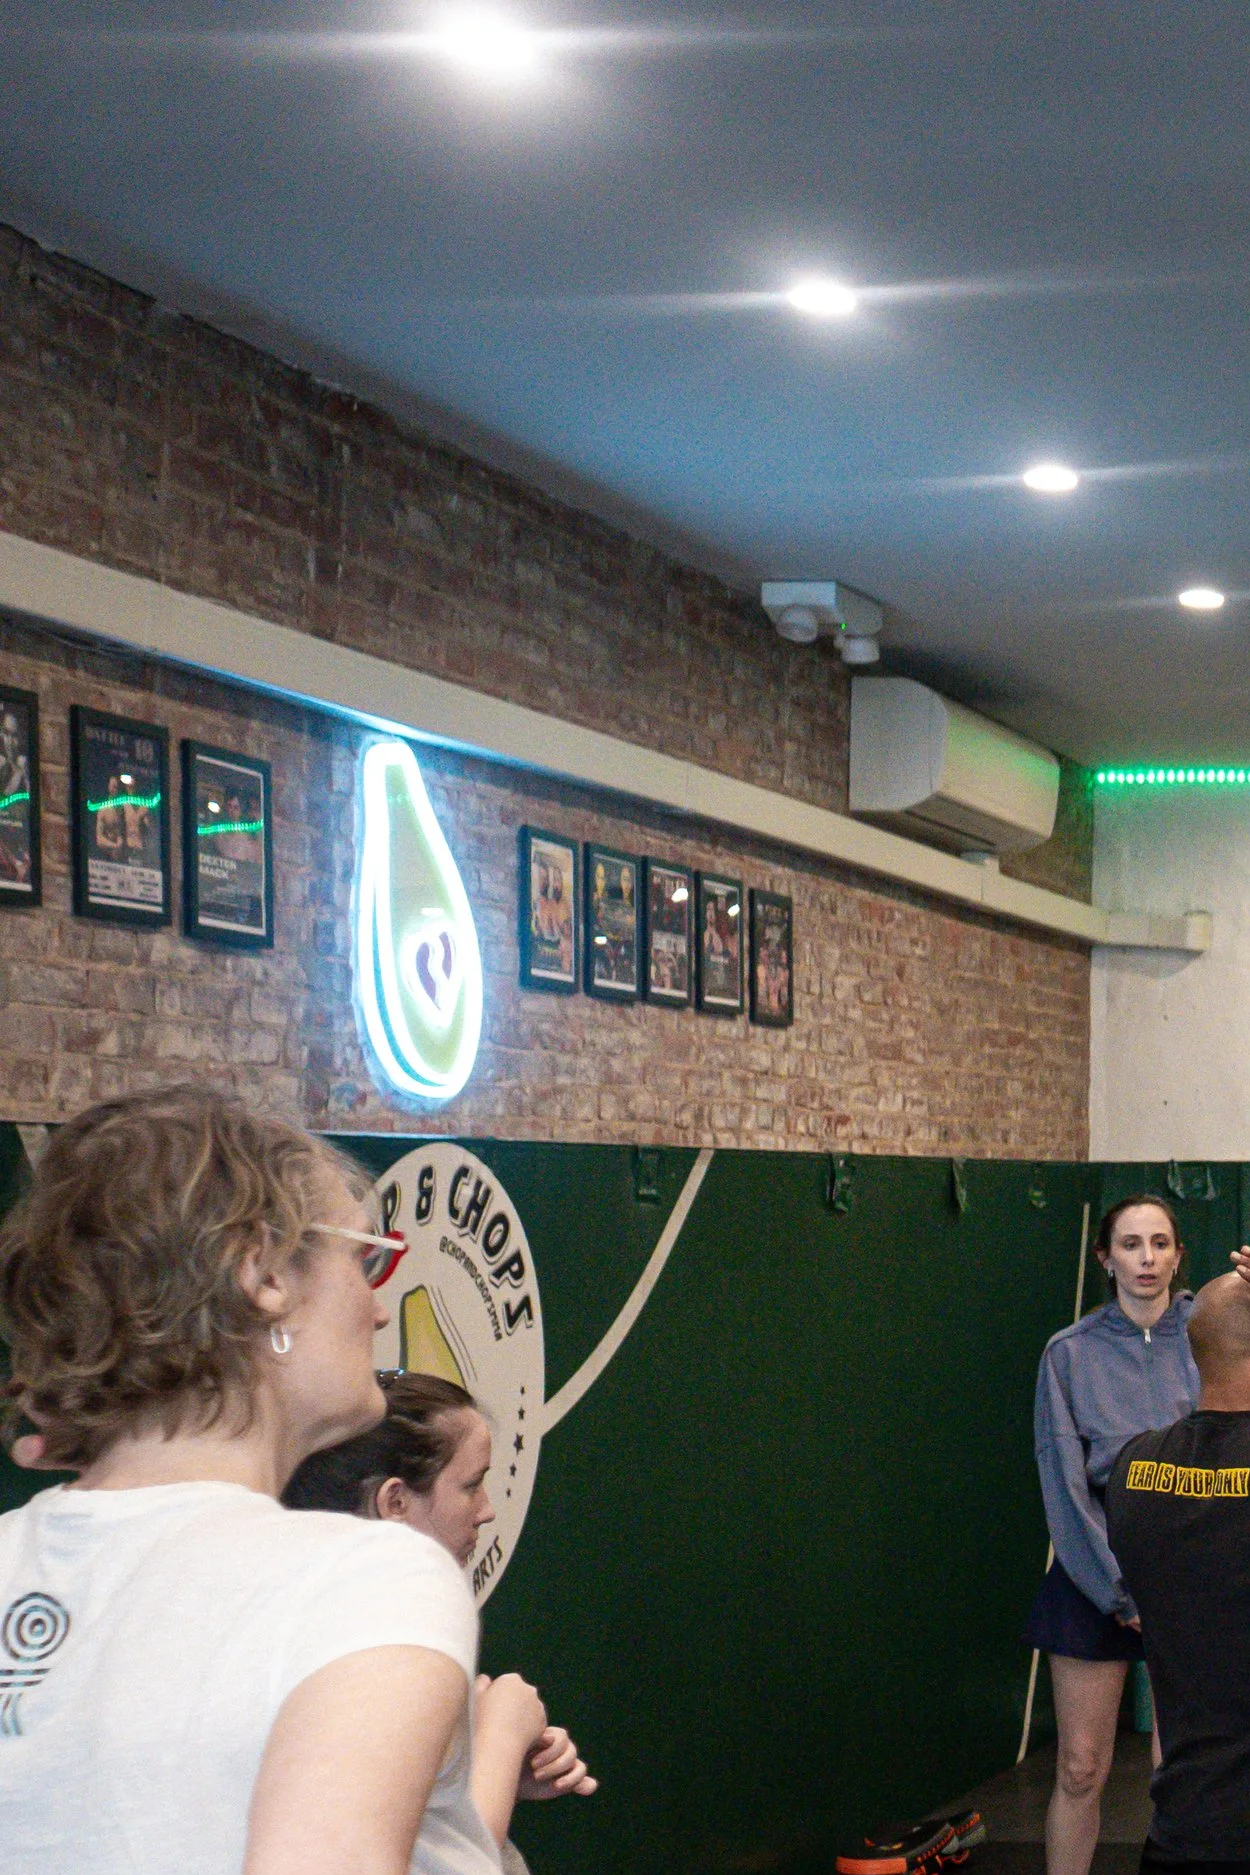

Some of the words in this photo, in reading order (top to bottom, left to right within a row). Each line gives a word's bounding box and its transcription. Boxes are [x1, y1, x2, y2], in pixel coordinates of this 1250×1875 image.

[415, 1164, 437, 1227] &
[448, 1163, 534, 1337] CHOPS
[1126, 1460, 1158, 1490] FEAR
[1155, 1462, 1176, 1493] IS
[1174, 1466, 1215, 1498] YOUR
[1213, 1467, 1250, 1497] ONLY
[472, 1534, 503, 1597] ARTS
